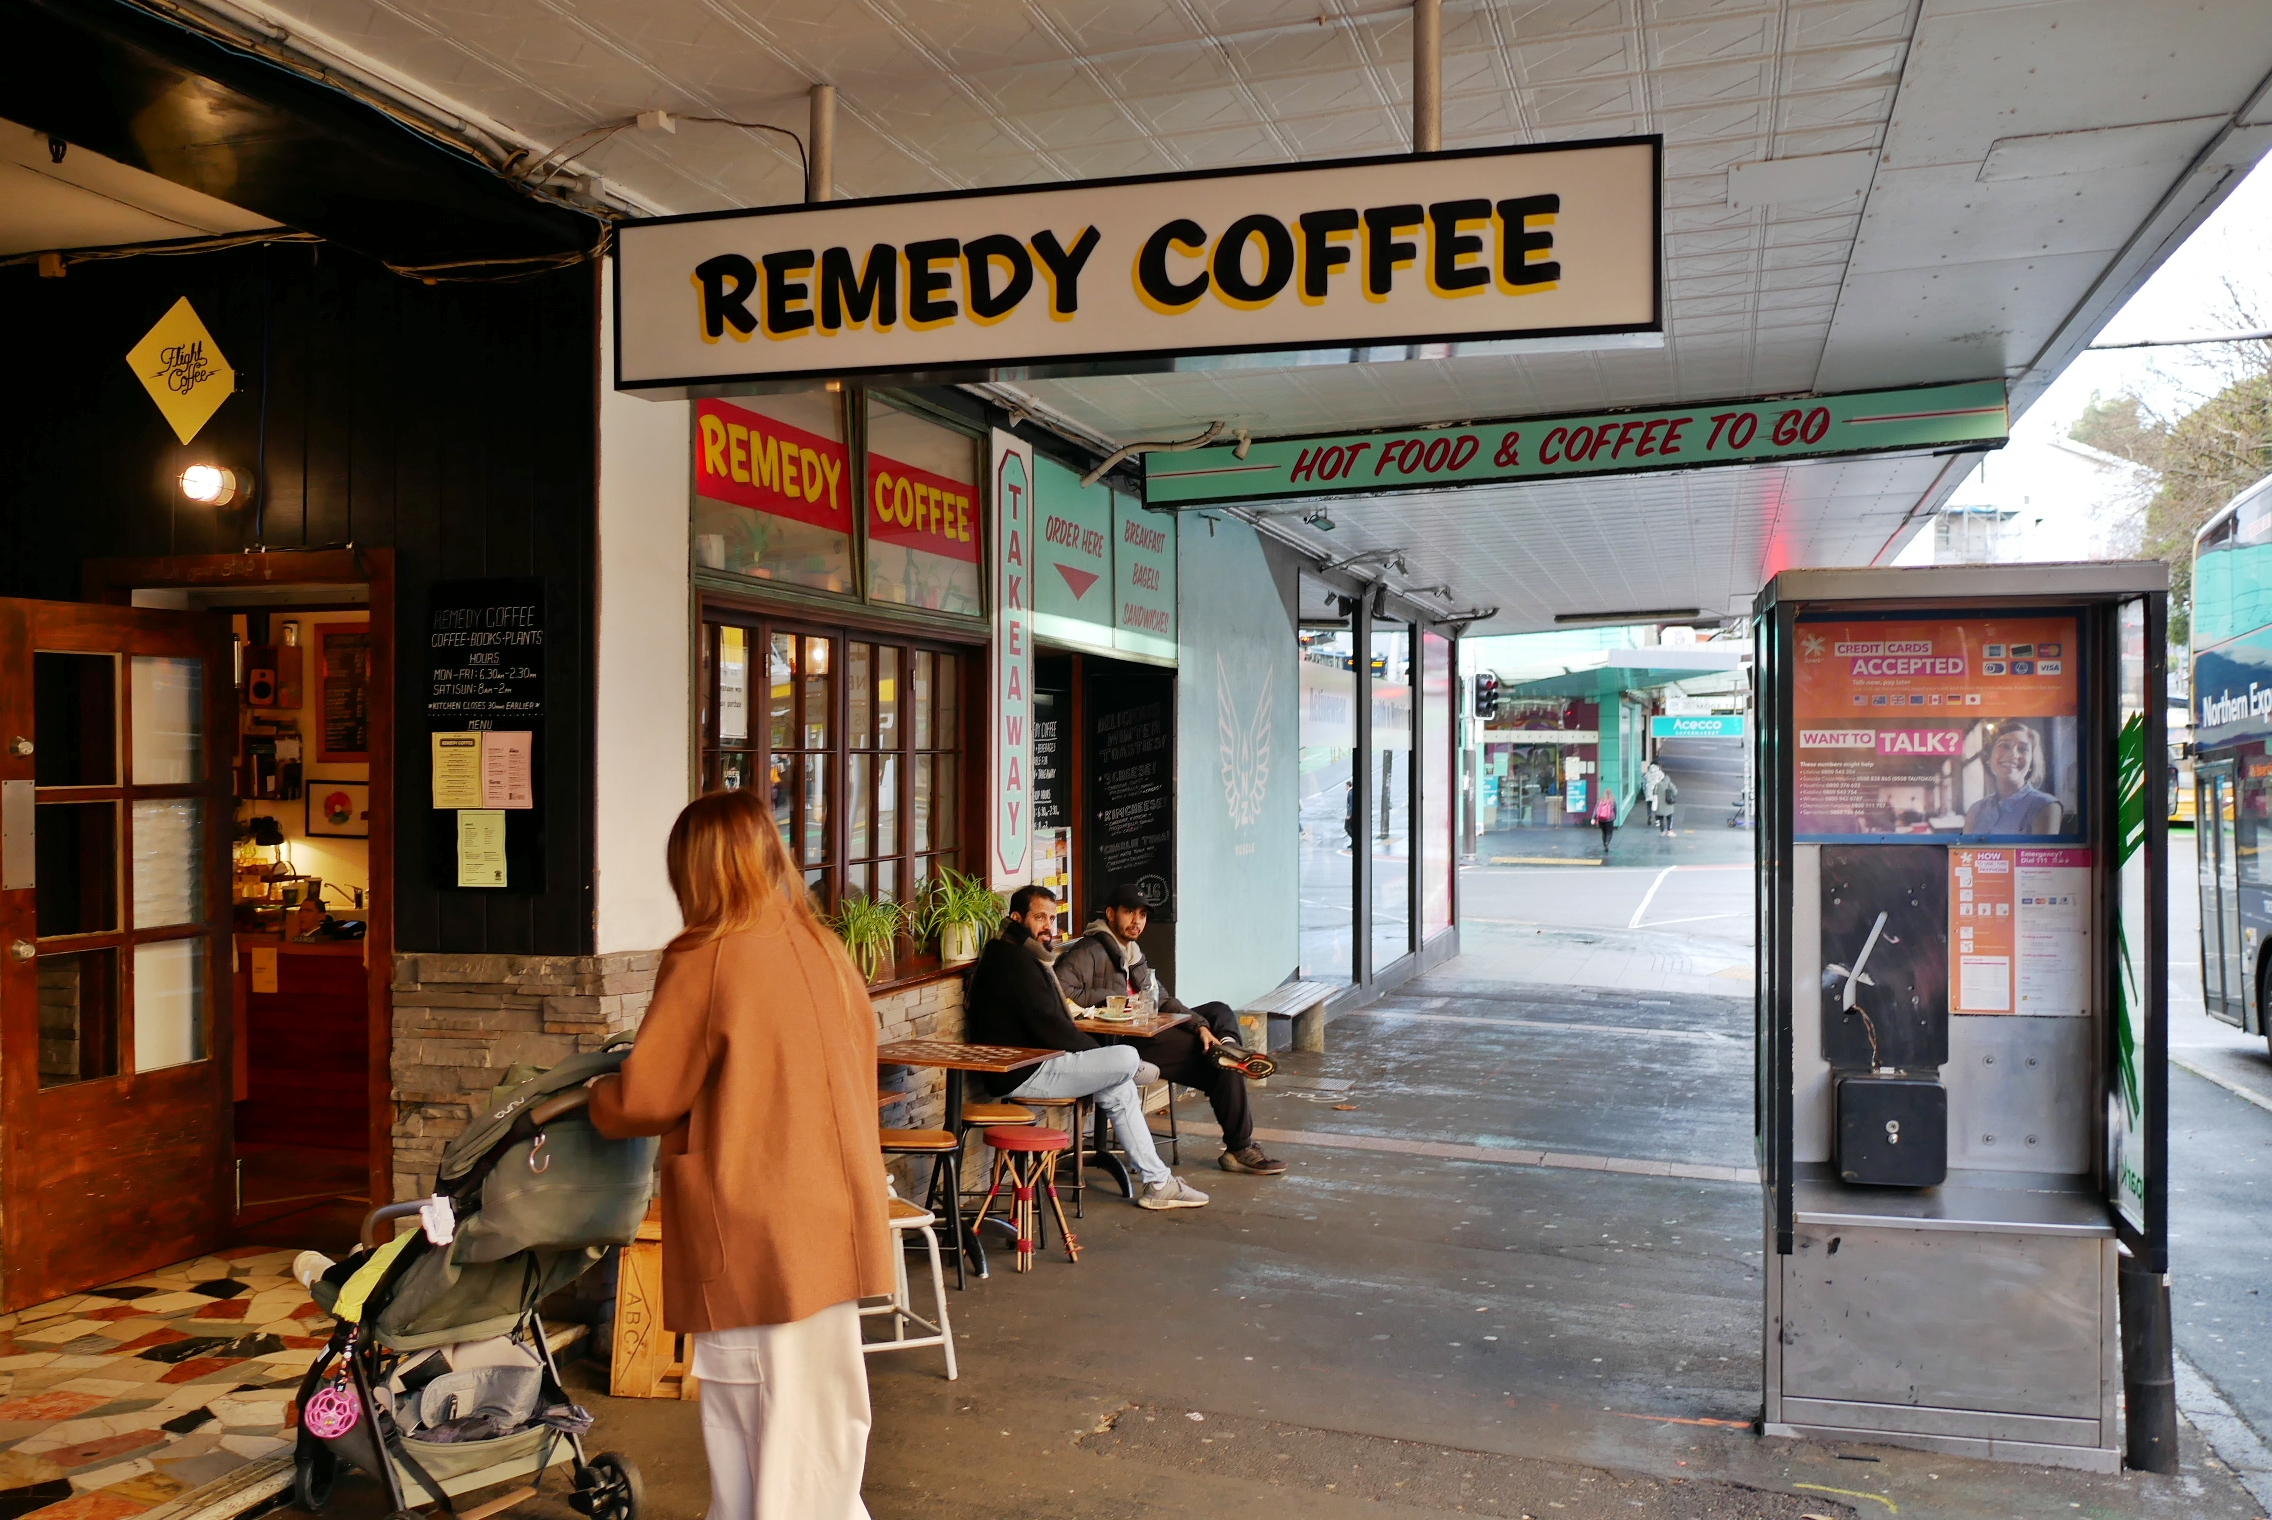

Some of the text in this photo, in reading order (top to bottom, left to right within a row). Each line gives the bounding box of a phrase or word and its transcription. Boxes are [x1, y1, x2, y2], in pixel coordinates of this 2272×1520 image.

[691, 193, 1562, 344] REMEDY COFFEE
[160, 340, 208, 373] Flight
[167, 362, 210, 395] Coffee
[1290, 406, 1832, 484] HOT FOOD & COFFEE TO GO
[698, 413, 971, 544] REMEDY COFFEE
[1045, 514, 1104, 559] ORDER HERE
[1123, 519, 1166, 554] BREAKFAST
[1132, 562, 1160, 592] BAGELS
[434, 605, 536, 629] REMEDY COFFEE
[1121, 602, 1170, 634] SANDWICHES
[469, 651, 500, 664] HOURS
[1837, 642, 1930, 655] CREDIT CARDS
[1852, 657, 1965, 676] ACCEPTED
[2040, 663, 2060, 672] VISA
[1896, 678, 1912, 686] later
[462, 701, 486, 710] CLOSES
[2202, 681, 2272, 728] Northern Exp
[468, 720, 493, 730] MENU
[1673, 718, 1722, 731] Acecco
[1803, 733, 1872, 745] WANT TO
[1880, 732, 1960, 753] TALK?
[1977, 852, 2001, 860] HOW
[2020, 850, 2063, 859] Emergency?
[623, 1292, 642, 1346] ABC
